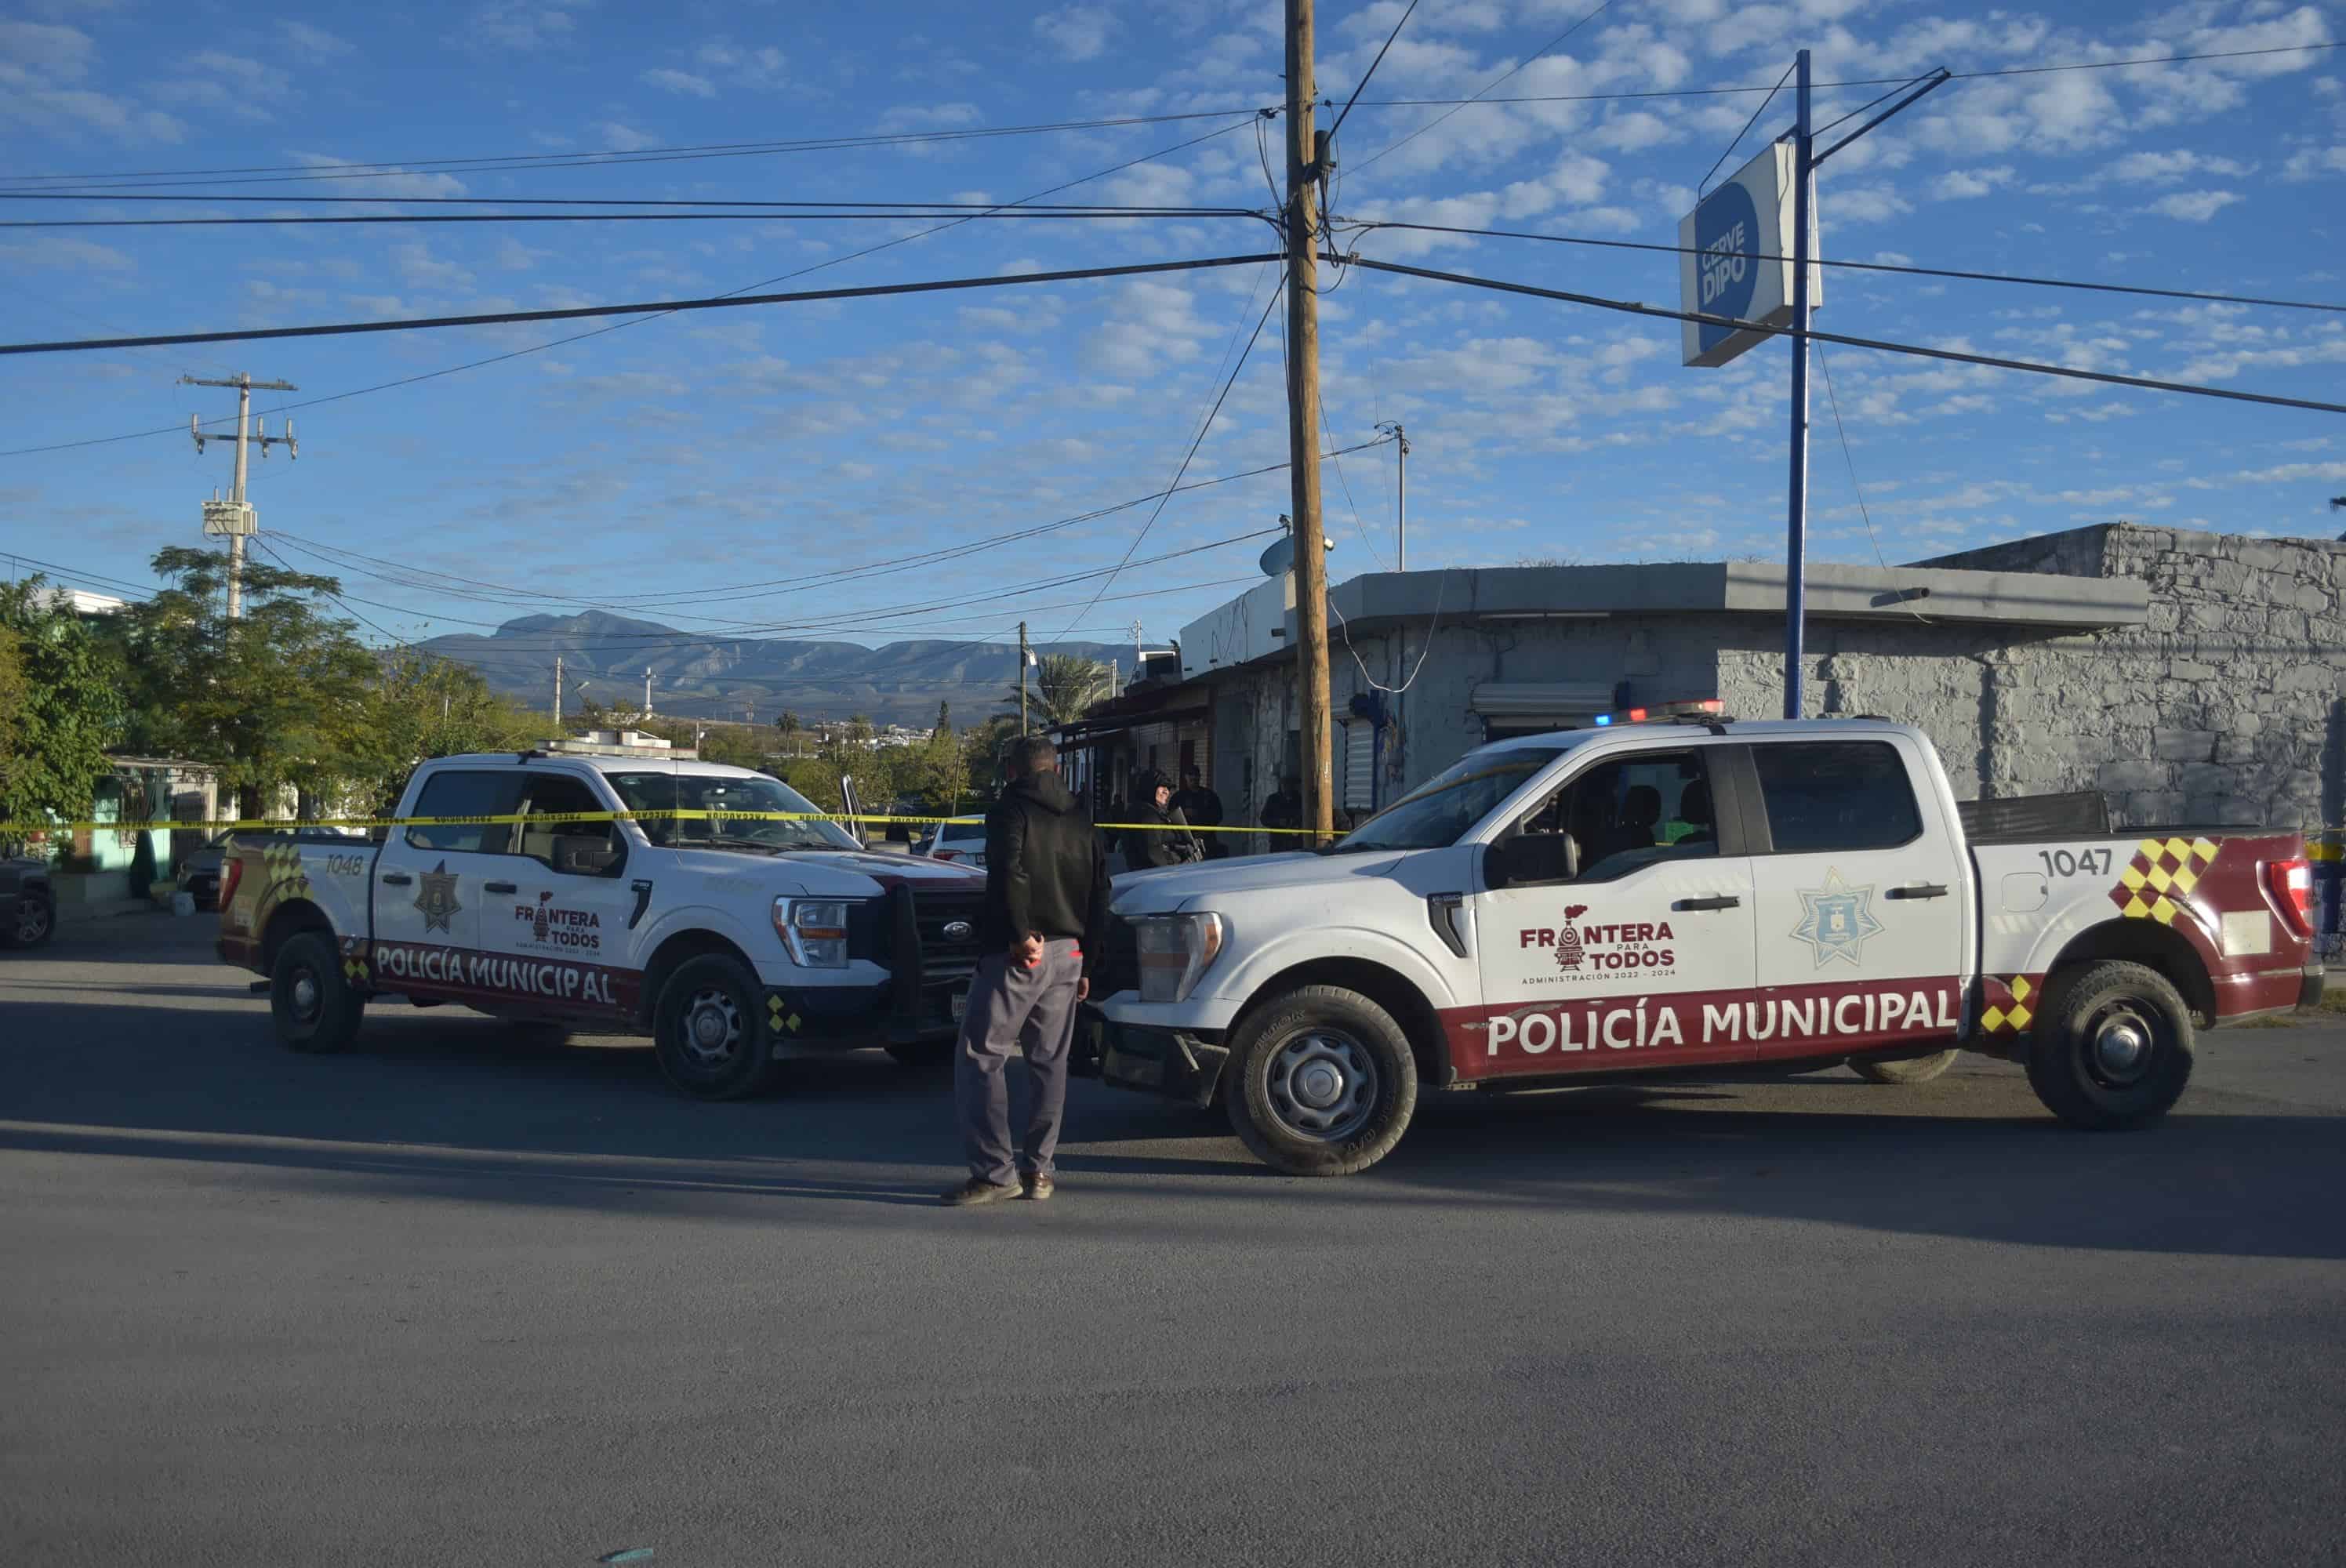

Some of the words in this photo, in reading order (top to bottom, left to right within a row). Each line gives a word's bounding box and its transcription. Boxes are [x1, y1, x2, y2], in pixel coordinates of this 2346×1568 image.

[1702, 220, 1745, 271] CERVE
[1703, 250, 1746, 307] DIPO
[524, 813, 581, 822] PRECAUCION
[613, 811, 673, 819] PRECAUCION
[706, 811, 768, 821] PRECAUCION
[326, 854, 363, 877] 1048
[2039, 848, 2112, 877] 1047
[551, 931, 600, 949] TODOS
[1520, 921, 1674, 948] FRONTERA
[1589, 949, 1675, 970] TODOS
[377, 946, 465, 983] POLICÍA
[470, 956, 616, 1004] MUNICIPAL
[1522, 972, 1610, 985] ADMINISTRACIÓN
[1488, 998, 1683, 1055] POLICÍA
[1702, 989, 1957, 1044] MUNICIPAL
